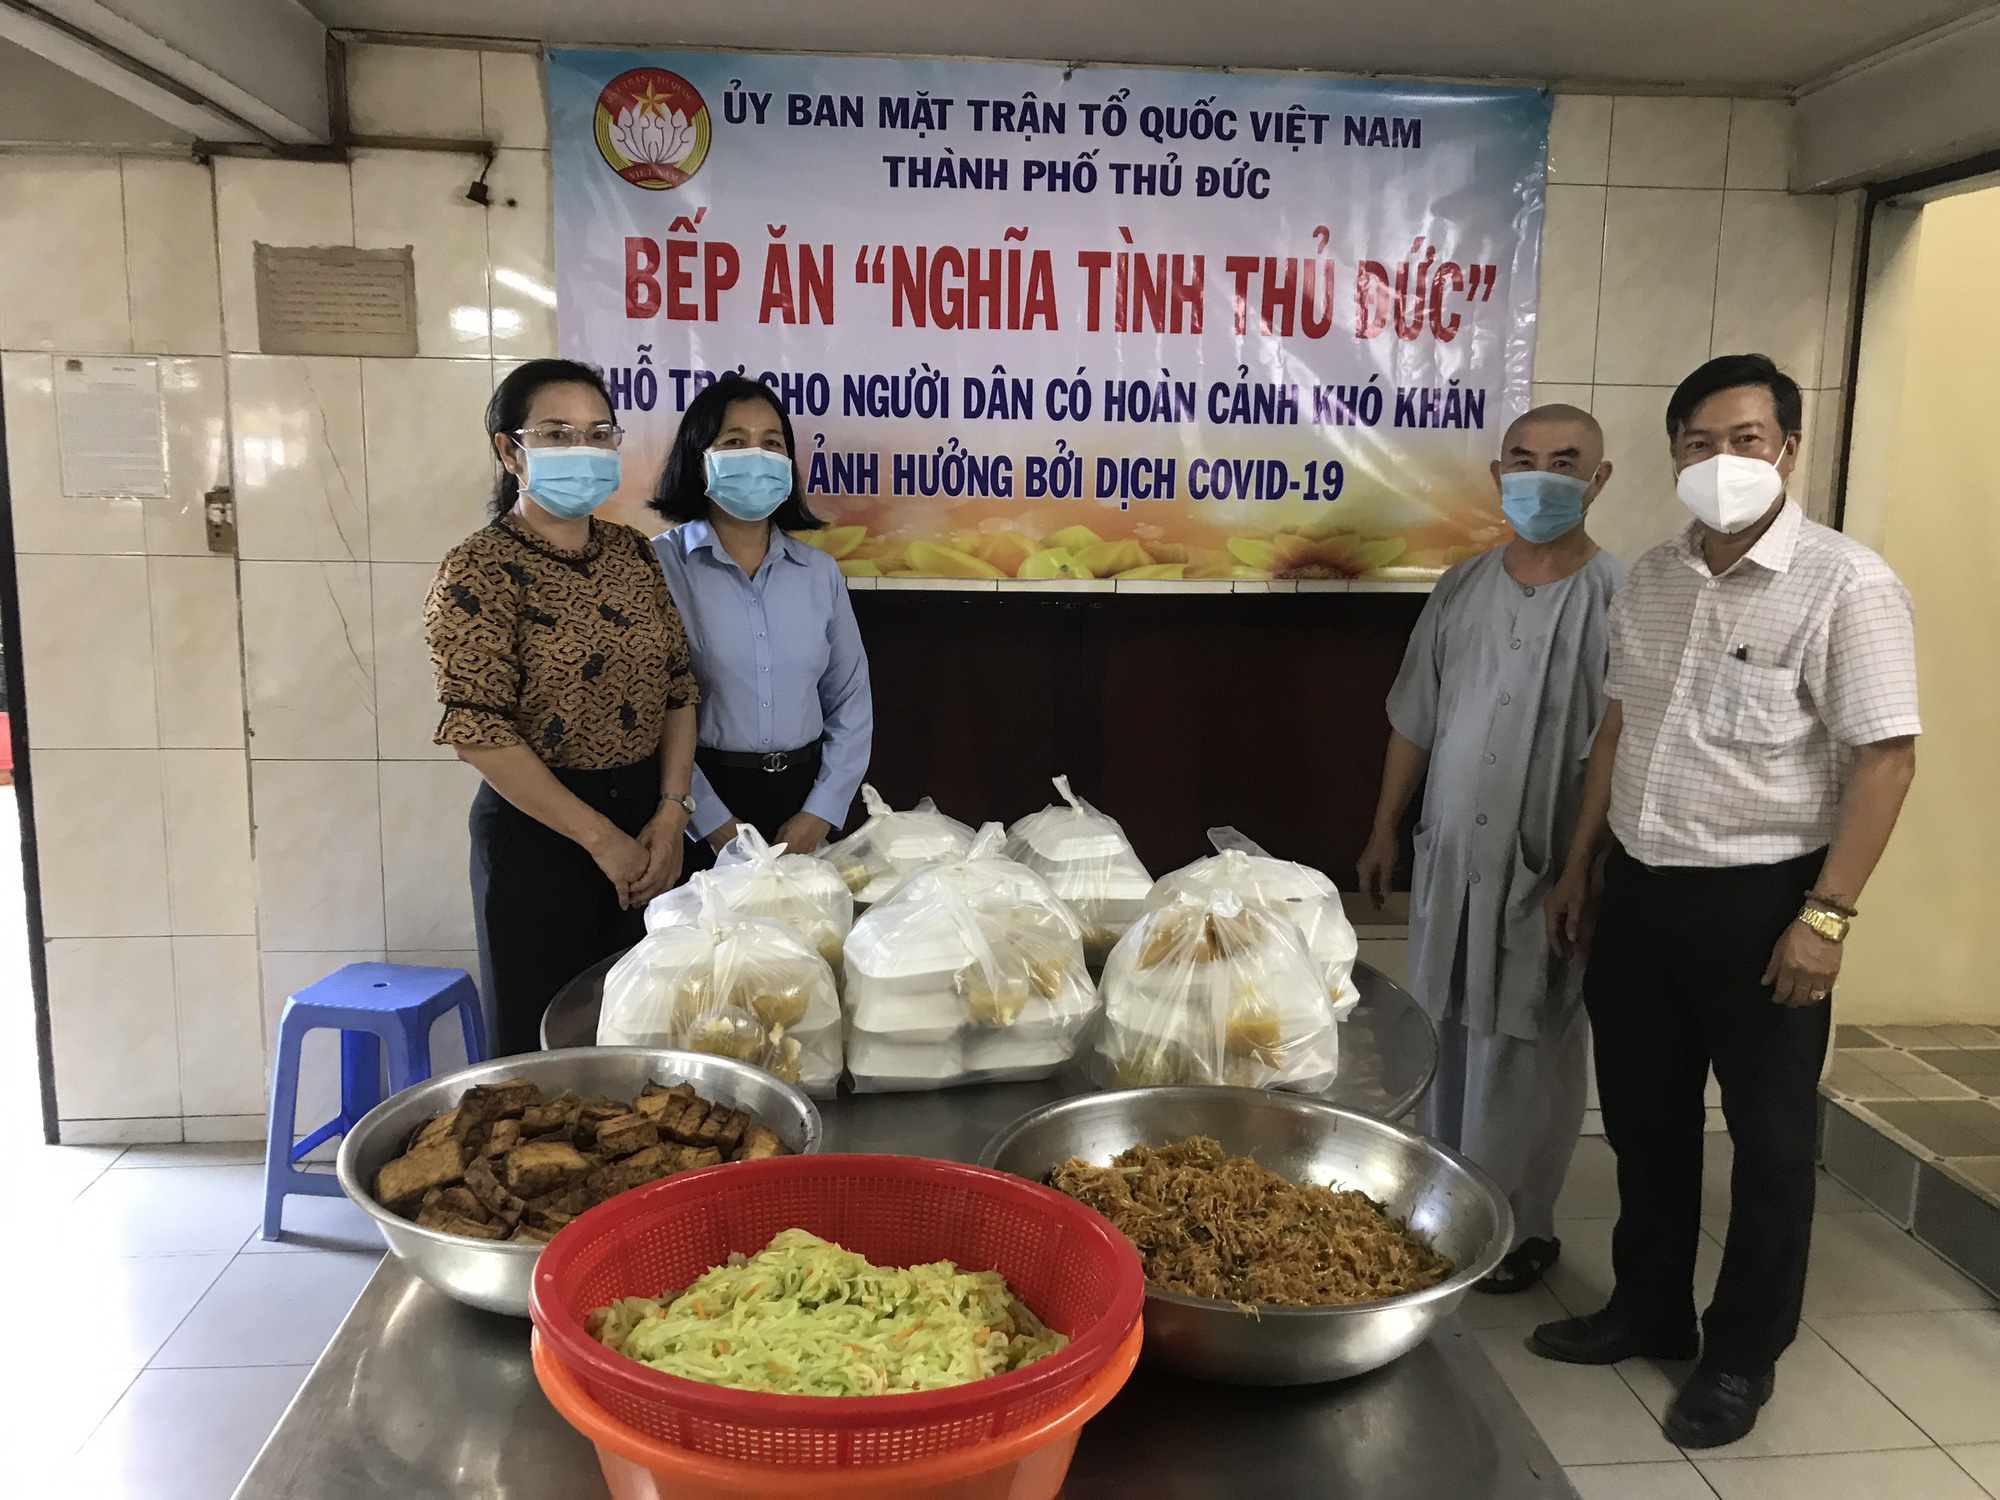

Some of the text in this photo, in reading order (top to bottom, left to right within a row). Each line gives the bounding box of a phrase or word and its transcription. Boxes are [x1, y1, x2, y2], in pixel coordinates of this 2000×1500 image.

[723, 77, 1422, 153] ỦY BAN MẶT TRẬN TỔ QUỐC VIỆT NAM
[882, 146, 1271, 200] THÀNH PHỐ THỦ ĐỨC
[624, 206, 1496, 343] BẾP ĂN “NGHĨA TÌNH THỦ ĐỨC”
[608, 343, 658, 412] HỖ
[843, 361, 949, 420] NGƯỜI
[963, 363, 1034, 421] DÂN
[1045, 365, 1092, 422] CÓ
[1104, 366, 1197, 423] HOÀN
[1207, 363, 1299, 425] CẢNH
[1313, 372, 1383, 427] KHÓ
[1393, 377, 1486, 430] KHĂN
[806, 431, 1344, 510] ẢNH HƯỞNG BỞI DỊCH COVID-19
